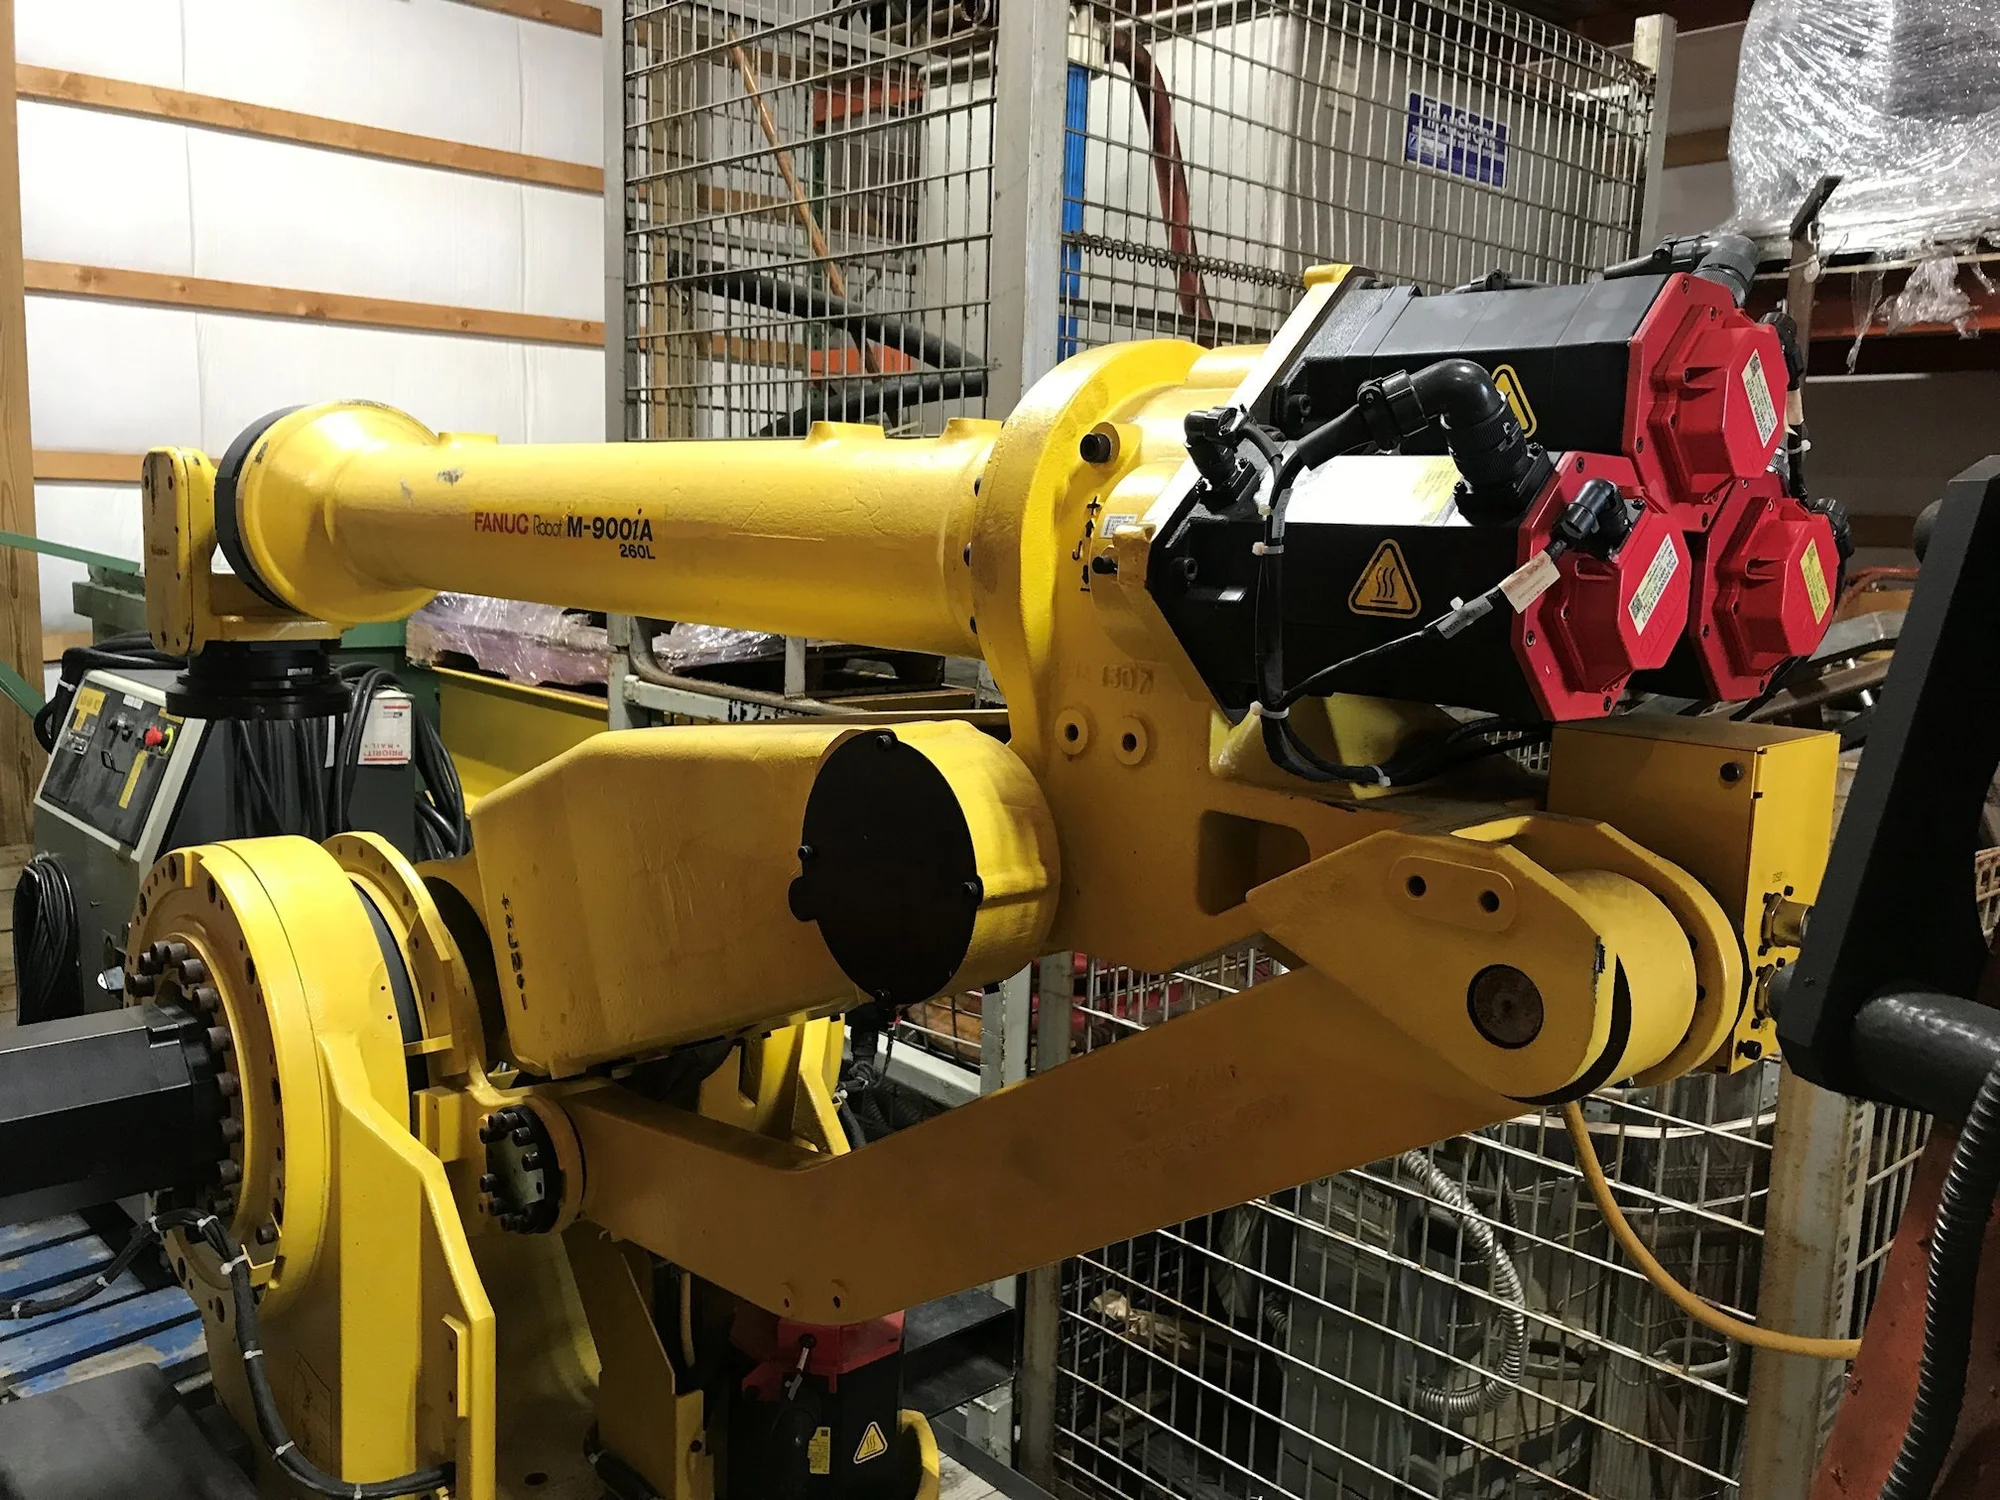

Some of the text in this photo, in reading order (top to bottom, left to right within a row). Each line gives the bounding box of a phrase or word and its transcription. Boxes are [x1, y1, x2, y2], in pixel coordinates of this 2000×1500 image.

[474, 512, 528, 535] FANUC
[533, 514, 563, 538] Robot
[619, 543, 656, 560] 260L
